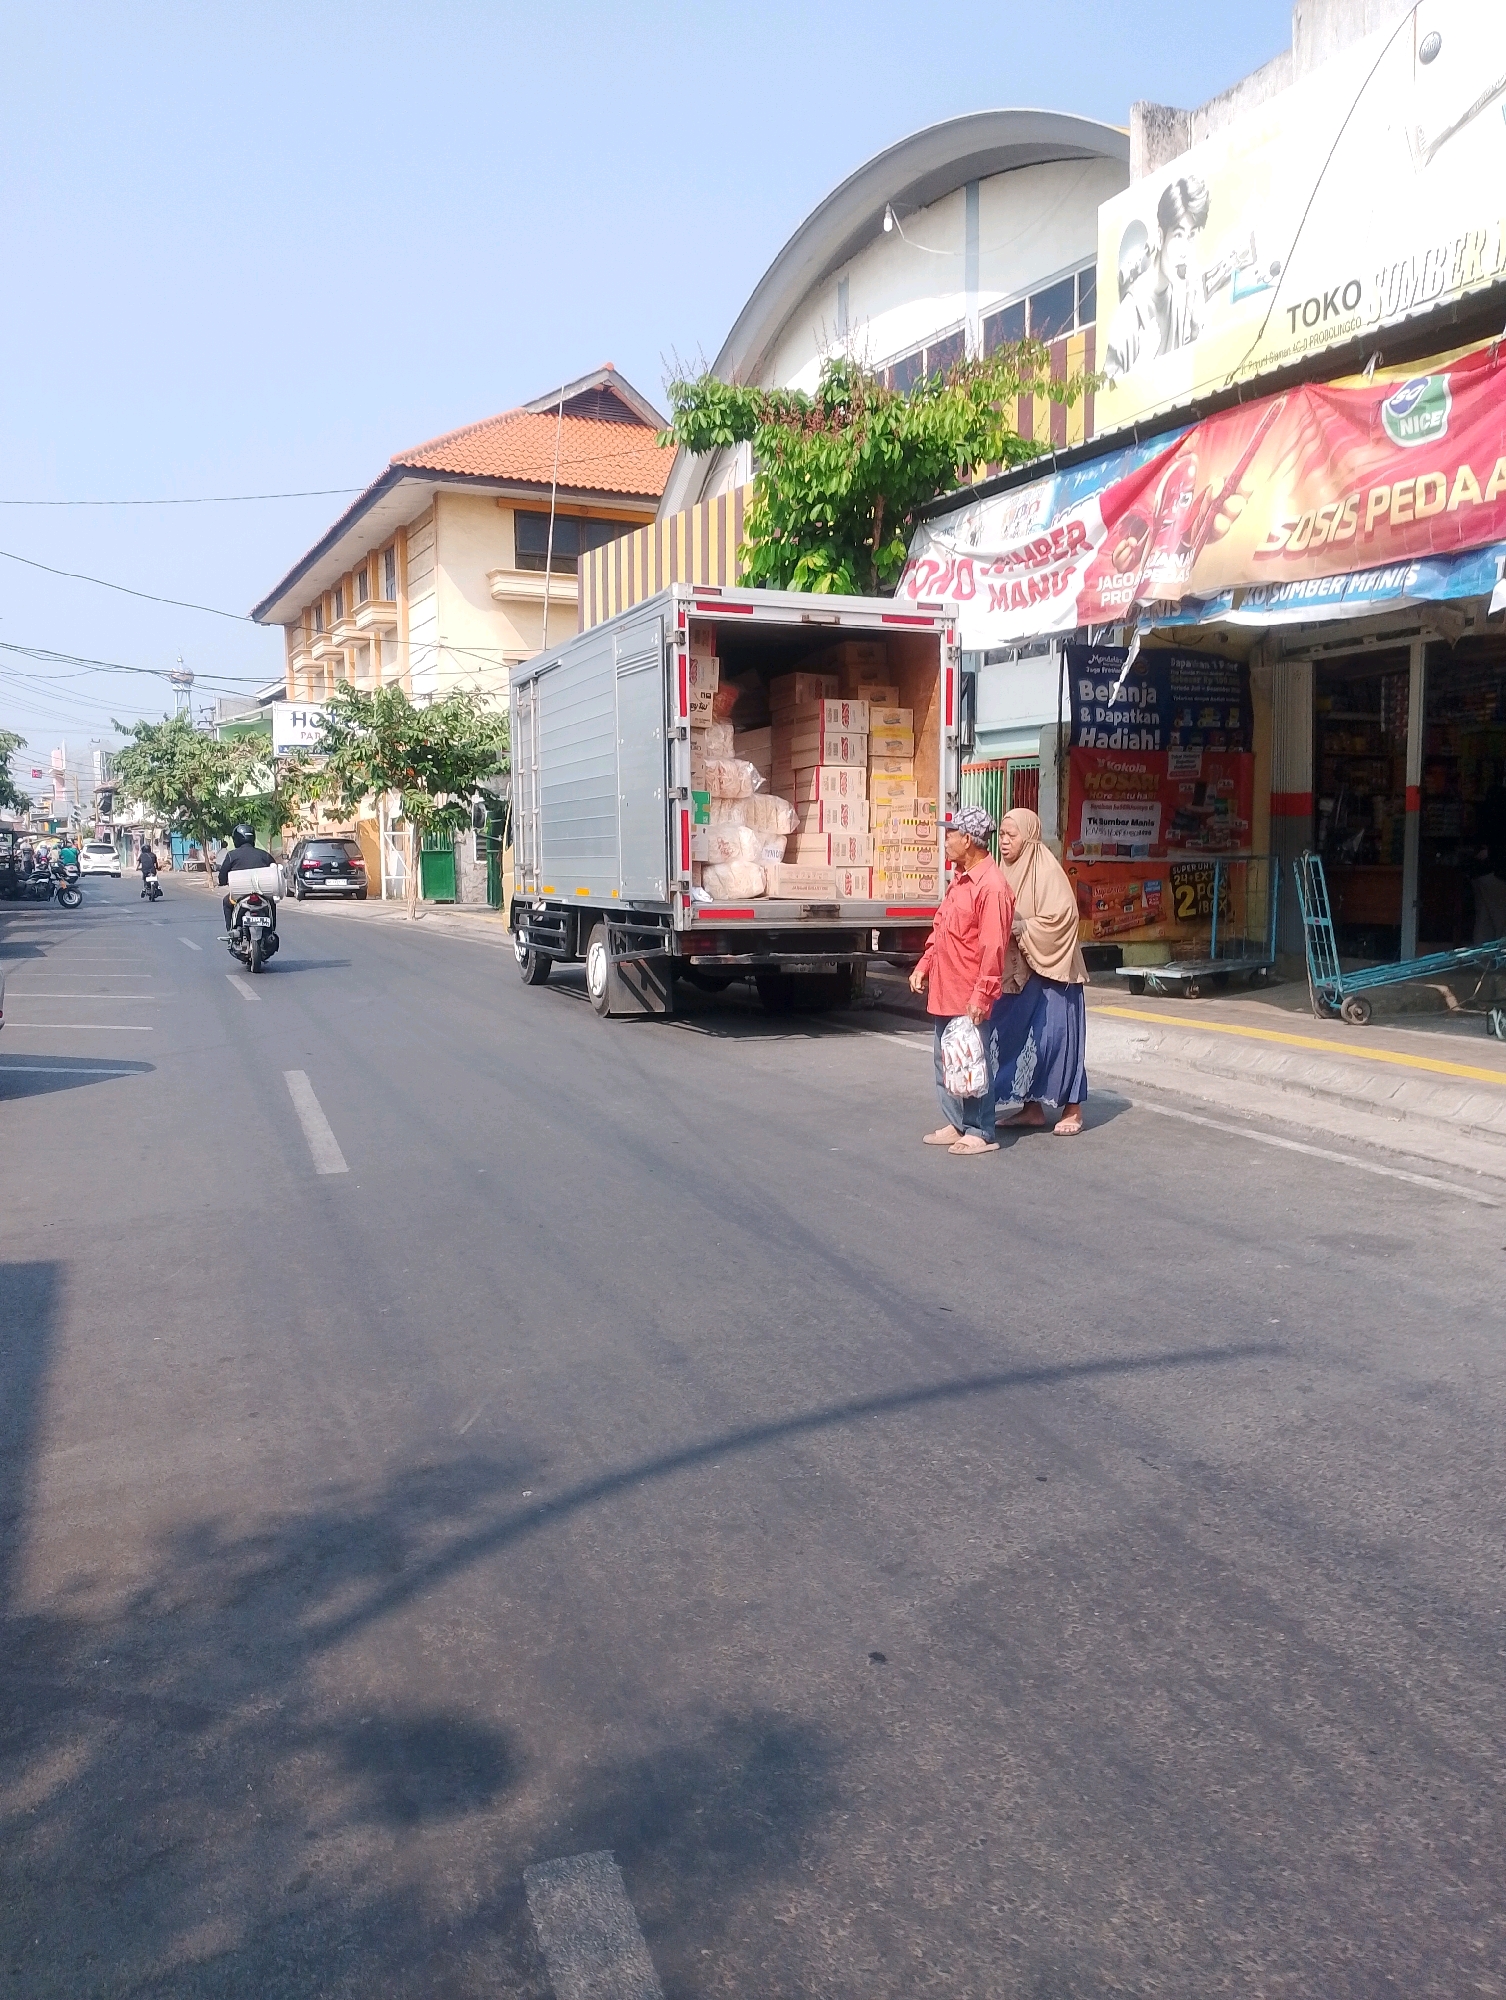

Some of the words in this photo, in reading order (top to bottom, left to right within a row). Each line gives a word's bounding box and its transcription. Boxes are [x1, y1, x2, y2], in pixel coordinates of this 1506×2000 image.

[1287, 279, 1362, 334] TOKO
[1393, 383, 1420, 405] SO
[1399, 409, 1444, 437] NICE
[1256, 493, 1361, 553] SOSIS
[987, 565, 1077, 614] MANIS
[1270, 576, 1346, 604] SUMBER
[1347, 564, 1421, 594] MANIS
[1078, 680, 1157, 707] Belanja
[290, 711, 352, 729] HOT
[1080, 707, 1091, 722] &
[1095, 707, 1160, 726] Dapatkan
[301, 731, 321, 740] PAR
[1078, 727, 1160, 750] Hadiah!
[1107, 760, 1147, 774] Kokola
[1172, 863, 1196, 875] SUPER
[1175, 885, 1197, 918] 2
